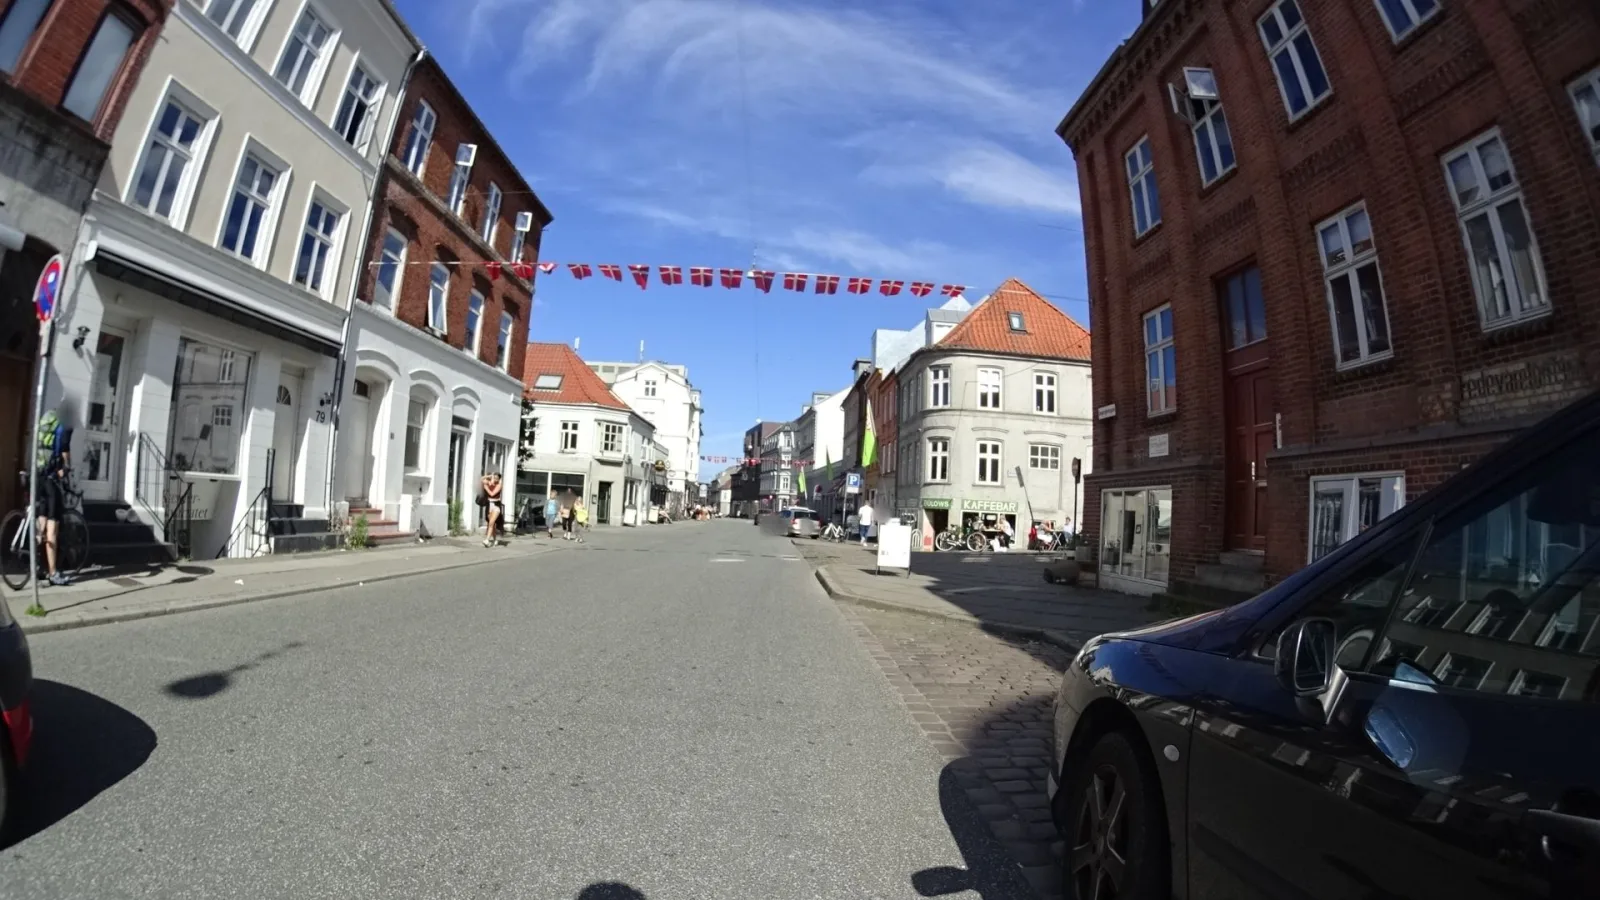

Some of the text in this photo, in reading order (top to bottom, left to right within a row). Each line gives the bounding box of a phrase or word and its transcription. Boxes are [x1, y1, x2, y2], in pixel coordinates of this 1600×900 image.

[315, 410, 326, 424] 79
[849, 475, 858, 485] P
[963, 499, 1016, 512] KAFFEBAR
